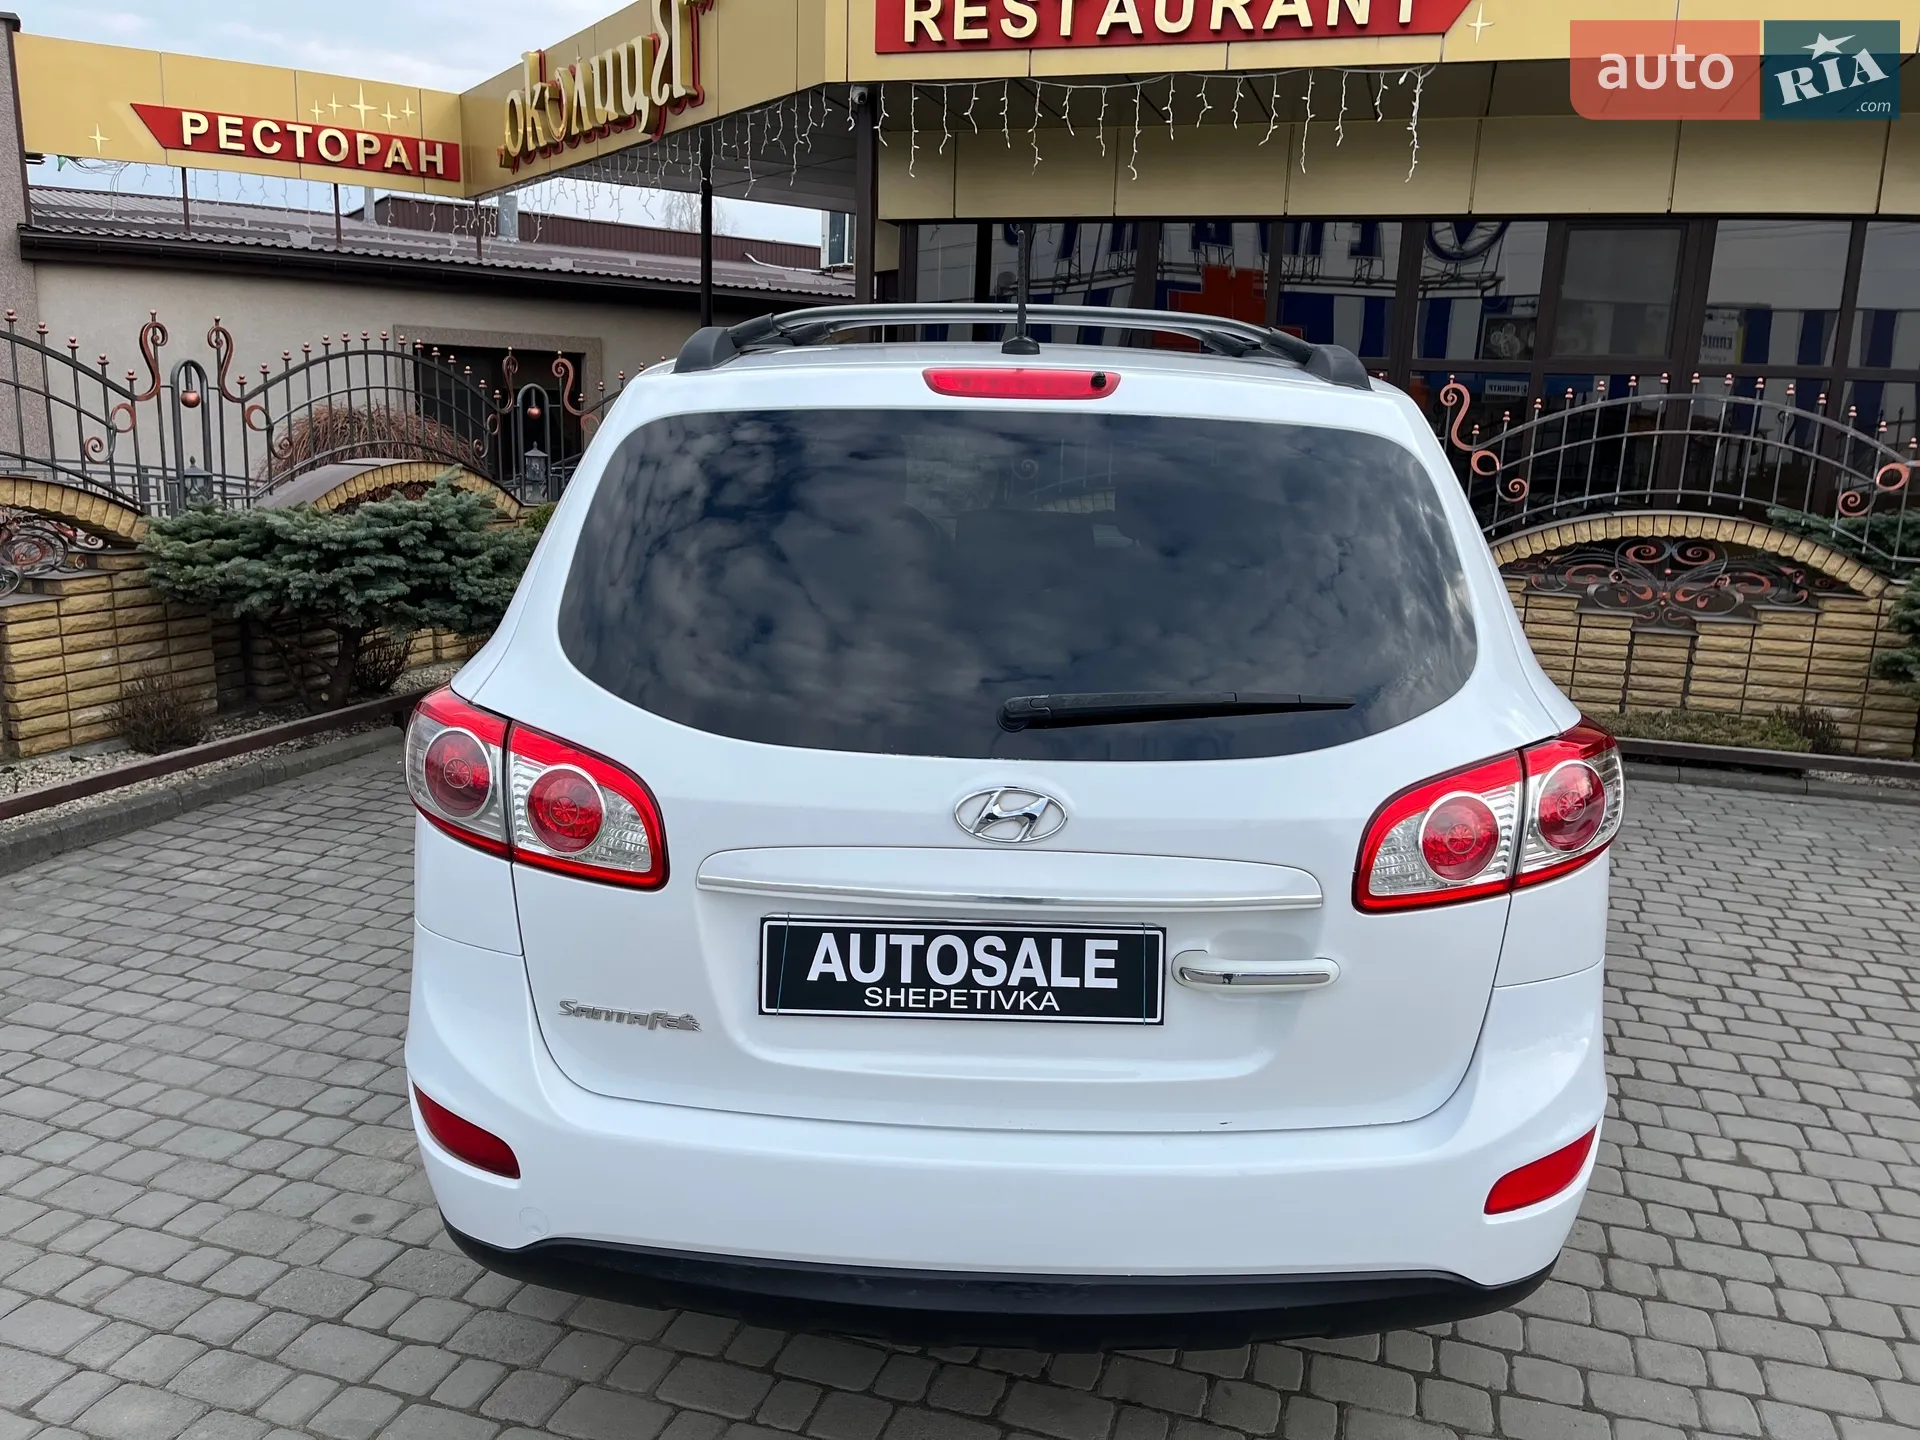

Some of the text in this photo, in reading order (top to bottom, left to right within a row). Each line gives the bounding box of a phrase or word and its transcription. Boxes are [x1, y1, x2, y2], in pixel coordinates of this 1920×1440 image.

[181, 111, 445, 175] РЕСТОРАН
[806, 932, 1118, 989] AUTOSALE
[863, 986, 1060, 1012] SHEPETIVKA
